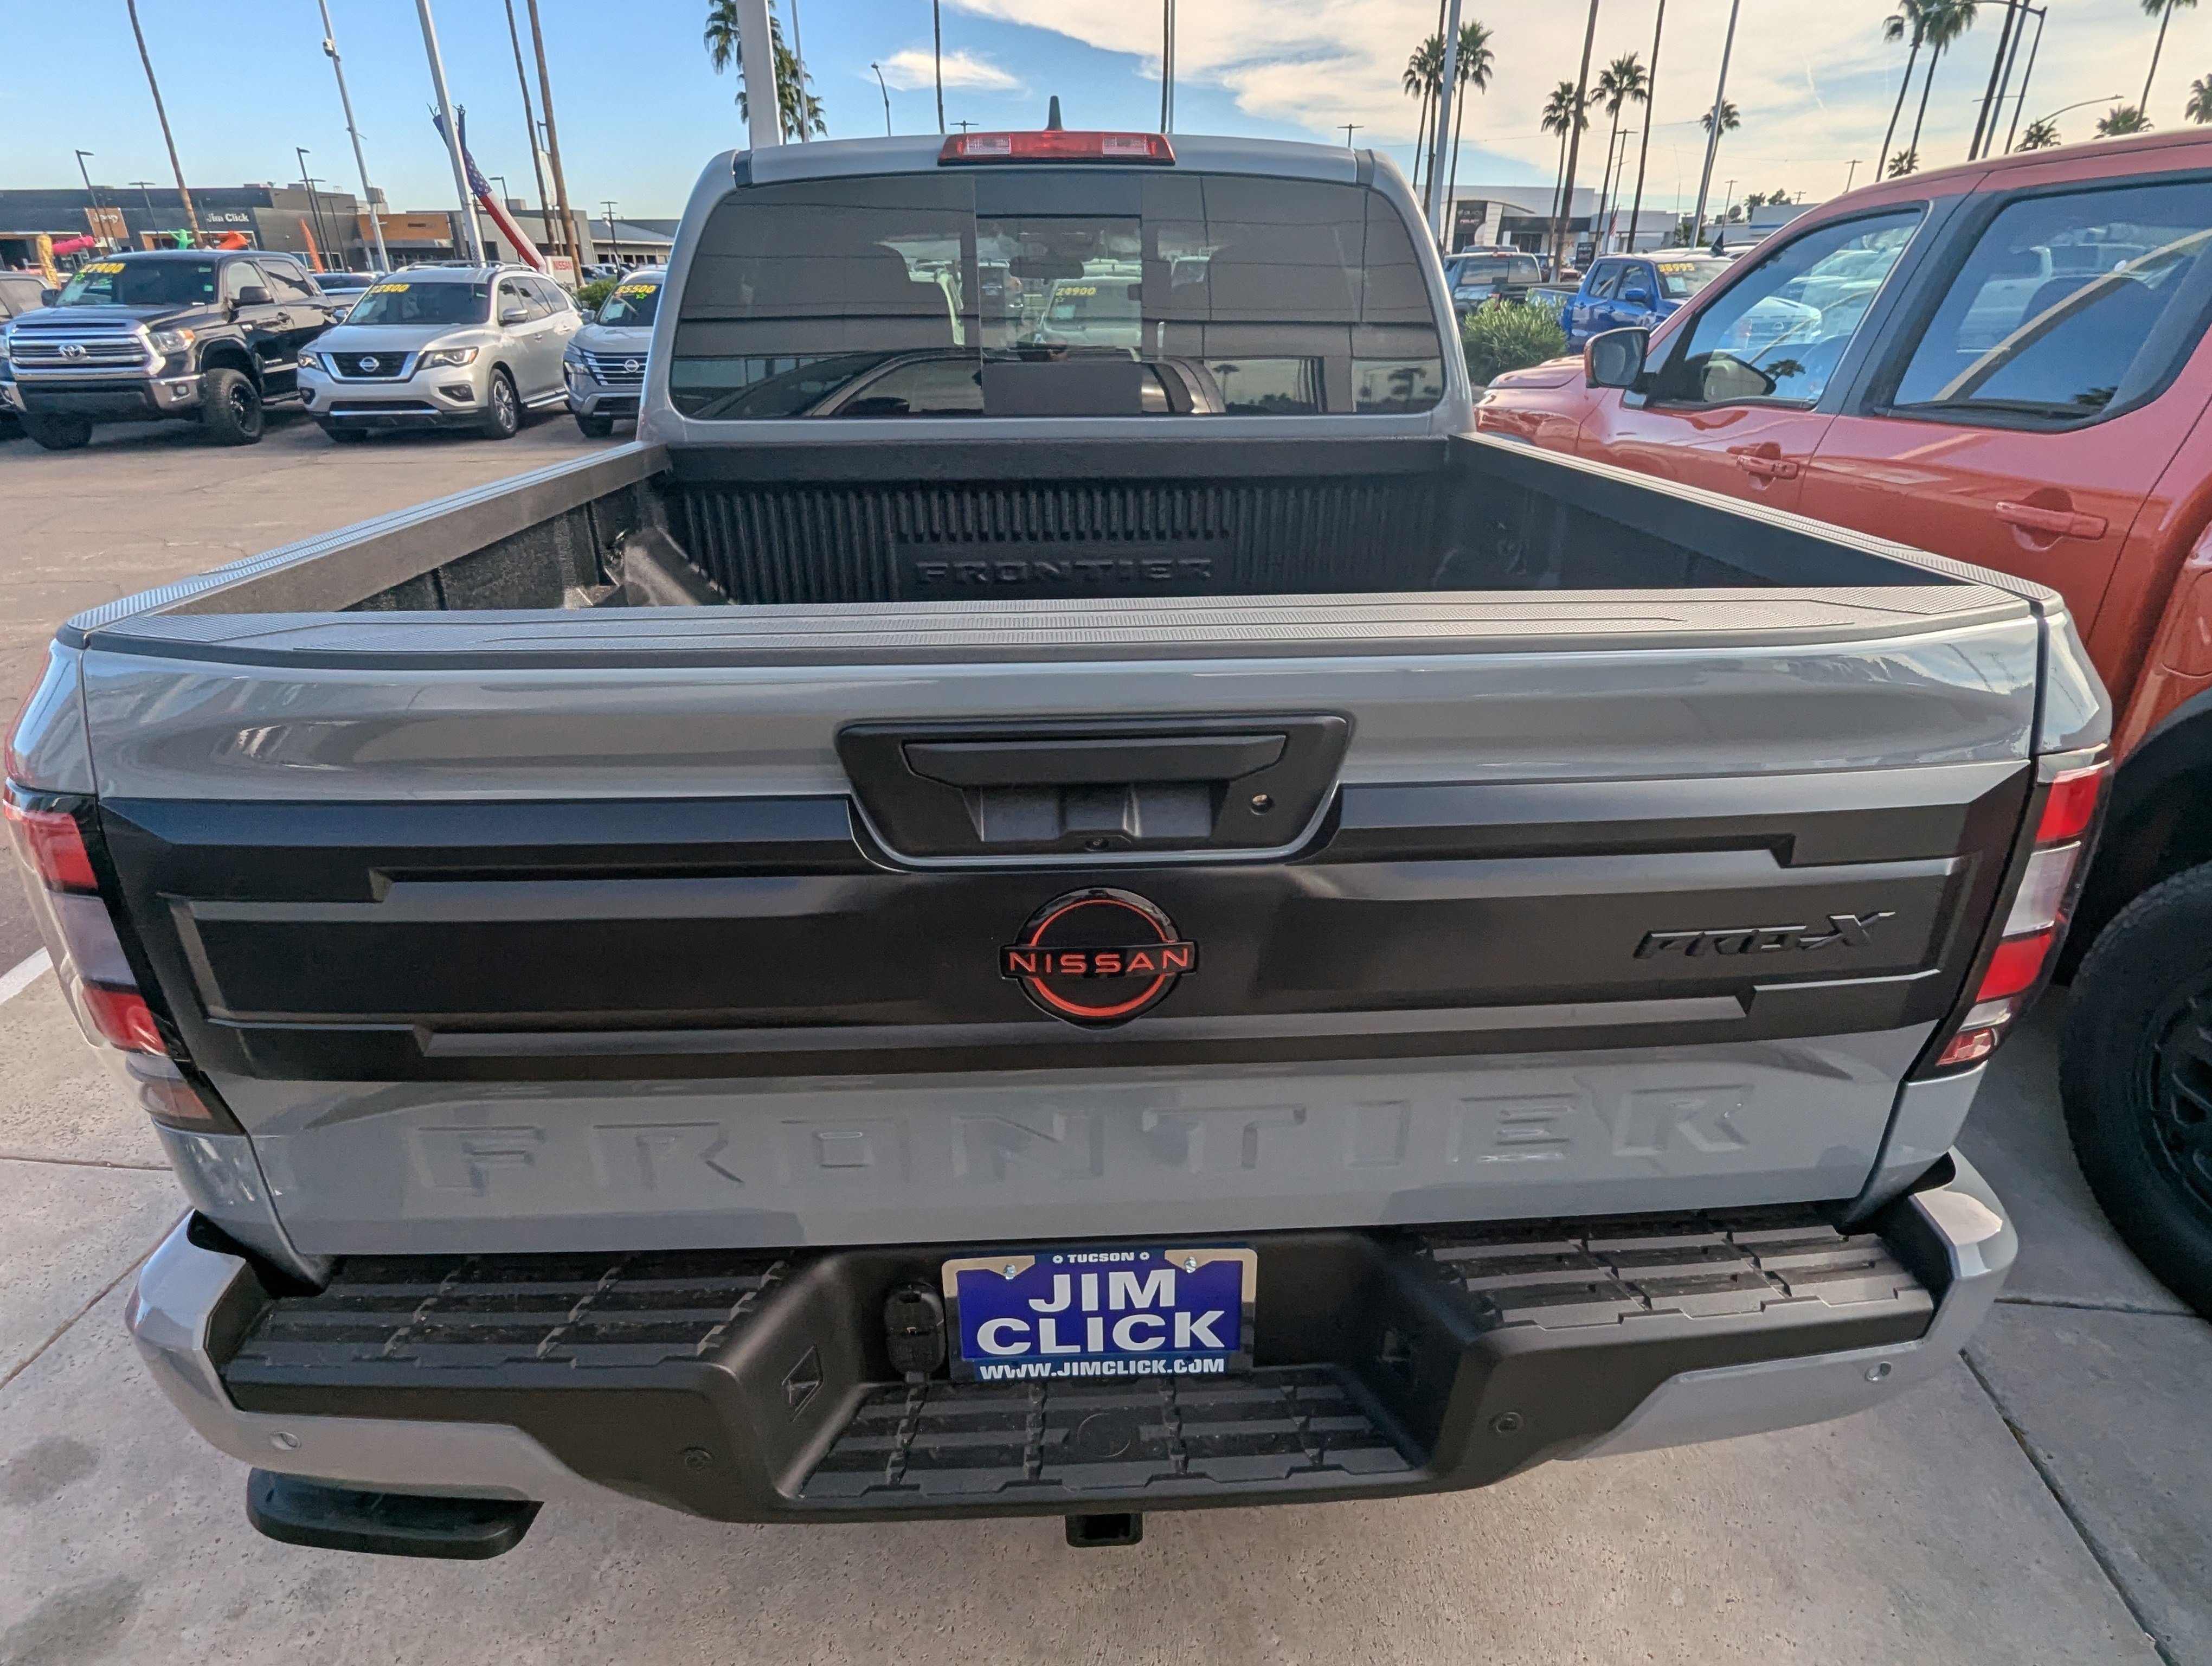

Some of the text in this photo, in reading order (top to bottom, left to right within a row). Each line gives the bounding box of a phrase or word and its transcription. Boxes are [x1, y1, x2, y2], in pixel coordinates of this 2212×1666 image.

[207, 213, 249, 222] Jim Click
[915, 558, 1212, 584] FRONTIER
[1008, 948, 1189, 973] NISSAN
[408, 1084, 1755, 1196] FRONTIER
[1068, 1252, 1134, 1264] TUCSON
[1028, 1268, 1175, 1312] JIM
[976, 1310, 1225, 1355] CLICK
[980, 1357, 1224, 1380] WWW.JIMCLICK.COM
